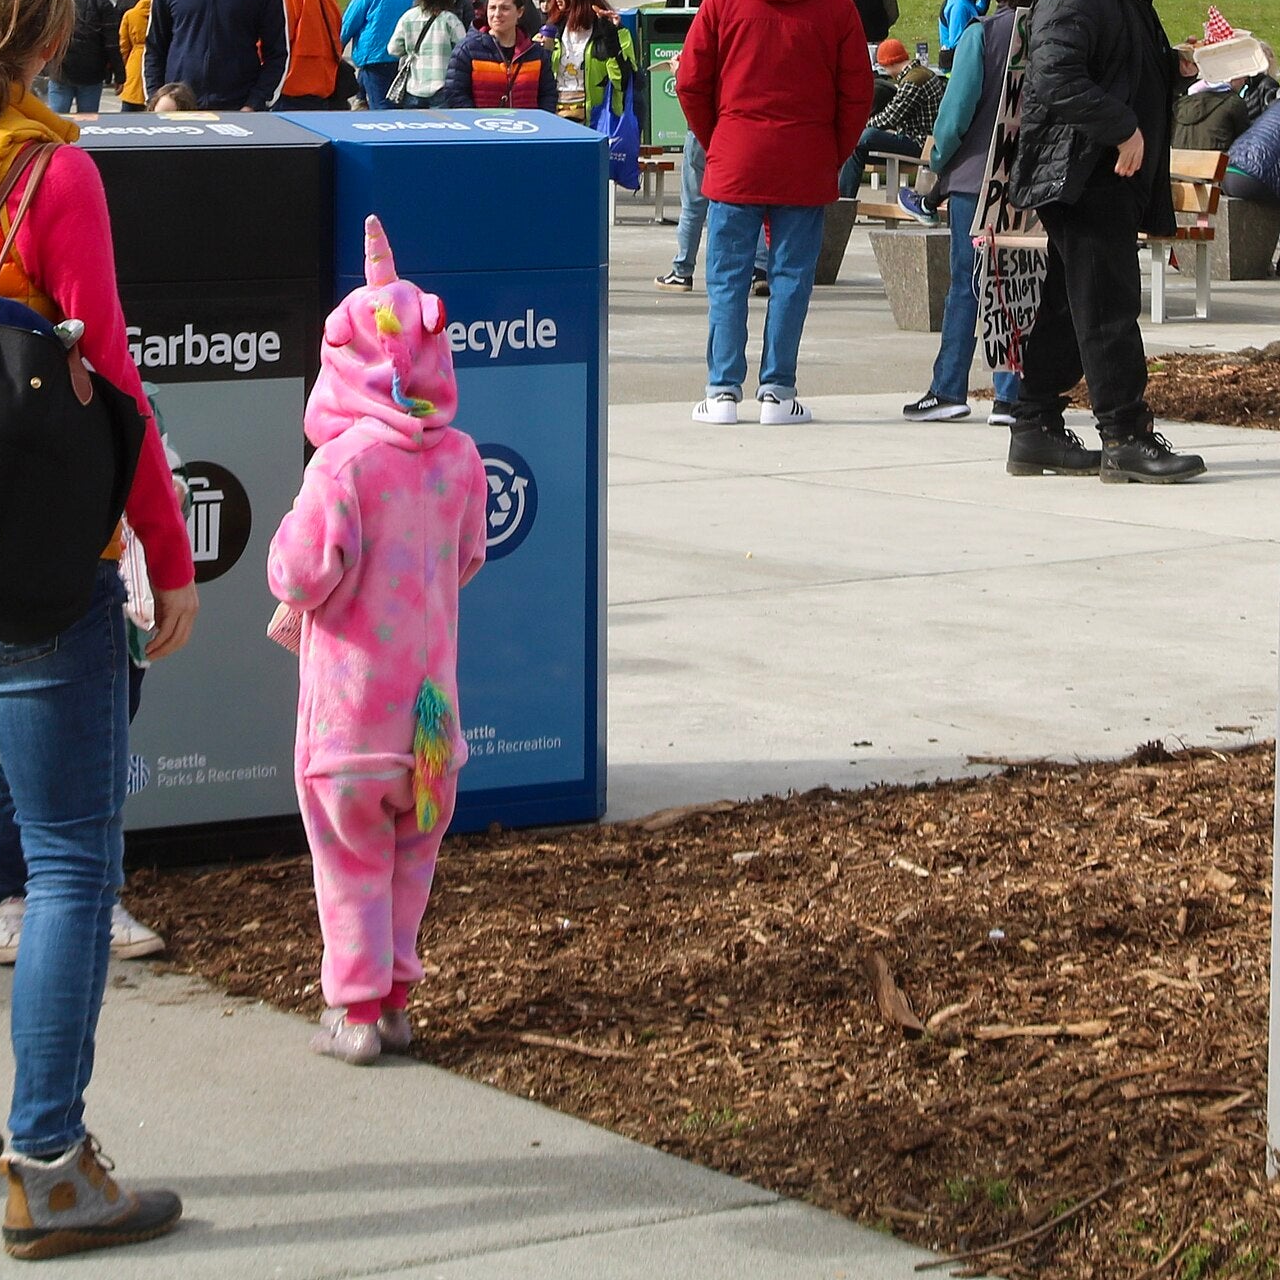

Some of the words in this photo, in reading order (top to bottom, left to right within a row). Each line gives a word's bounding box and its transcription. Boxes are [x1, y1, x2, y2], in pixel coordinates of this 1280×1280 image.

[352, 122, 471, 132] Recycle
[987, 247, 1048, 277] LESBIA
[448, 308, 558, 359] ecycle
[126, 324, 281, 372] Garbage
[498, 736, 561, 754] Recreation
[158, 752, 207, 770] Seattle
[158, 772, 193, 787] Parks
[196, 771, 206, 784] &
[208, 764, 278, 782] Recreation
